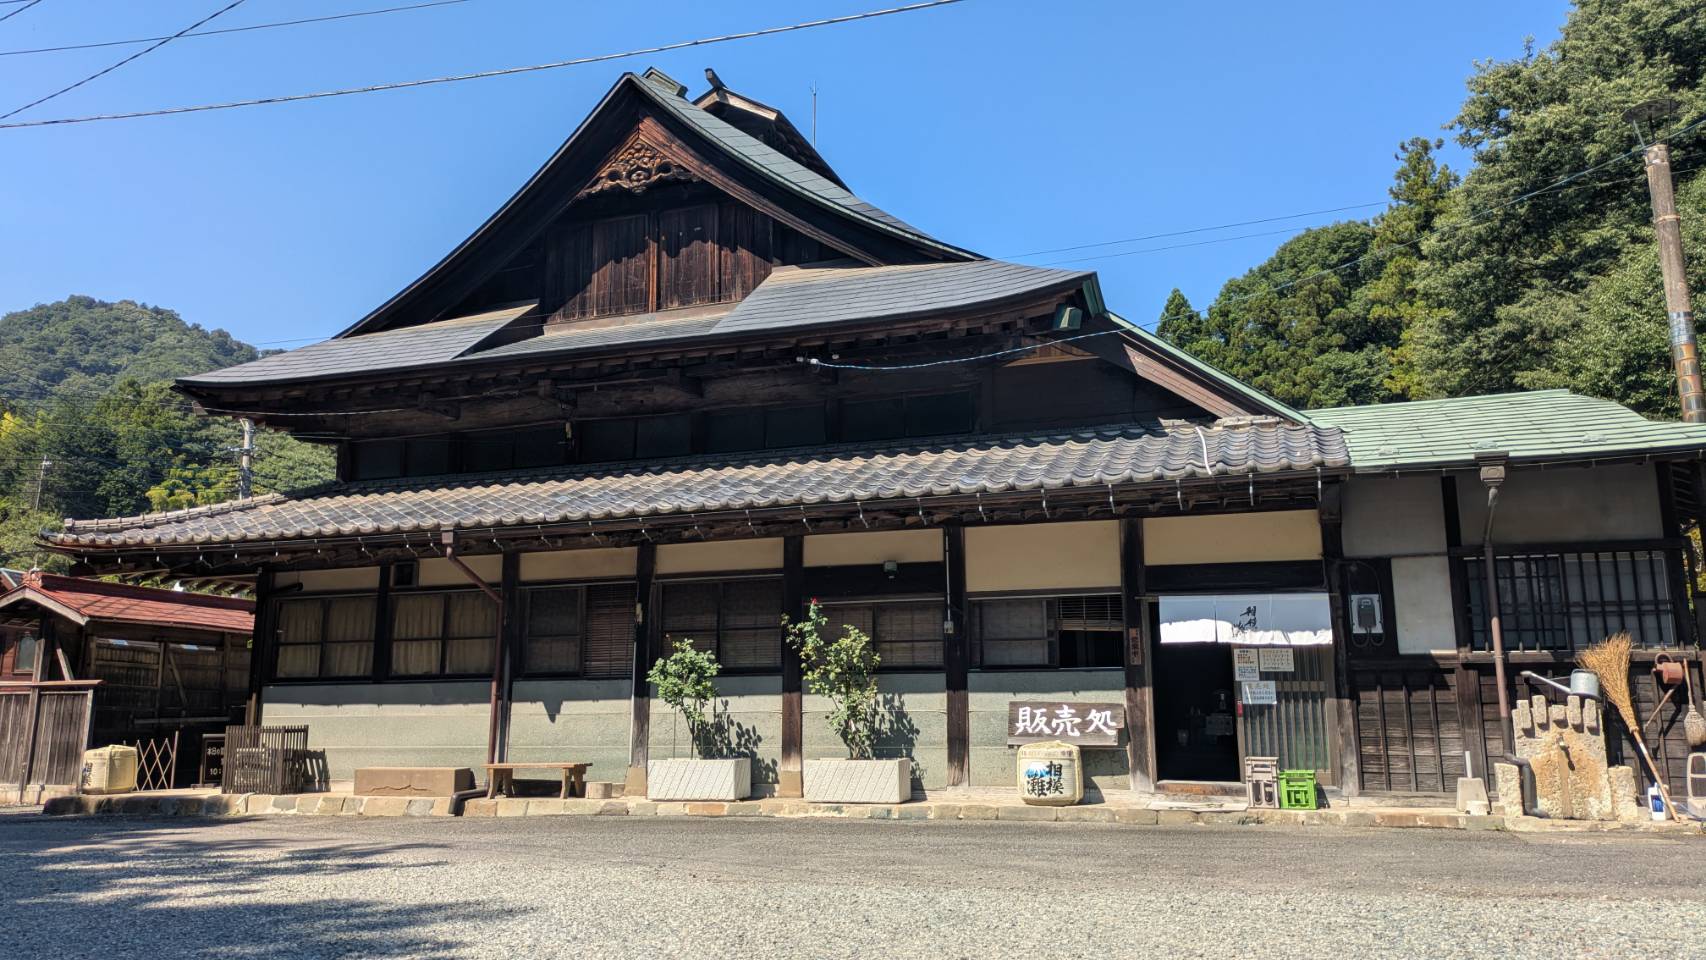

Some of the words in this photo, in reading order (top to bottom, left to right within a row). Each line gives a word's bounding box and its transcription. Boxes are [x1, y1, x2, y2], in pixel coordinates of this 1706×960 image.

[1014, 704, 1117, 737] 販売処
[1045, 760, 1064, 795] 相模
